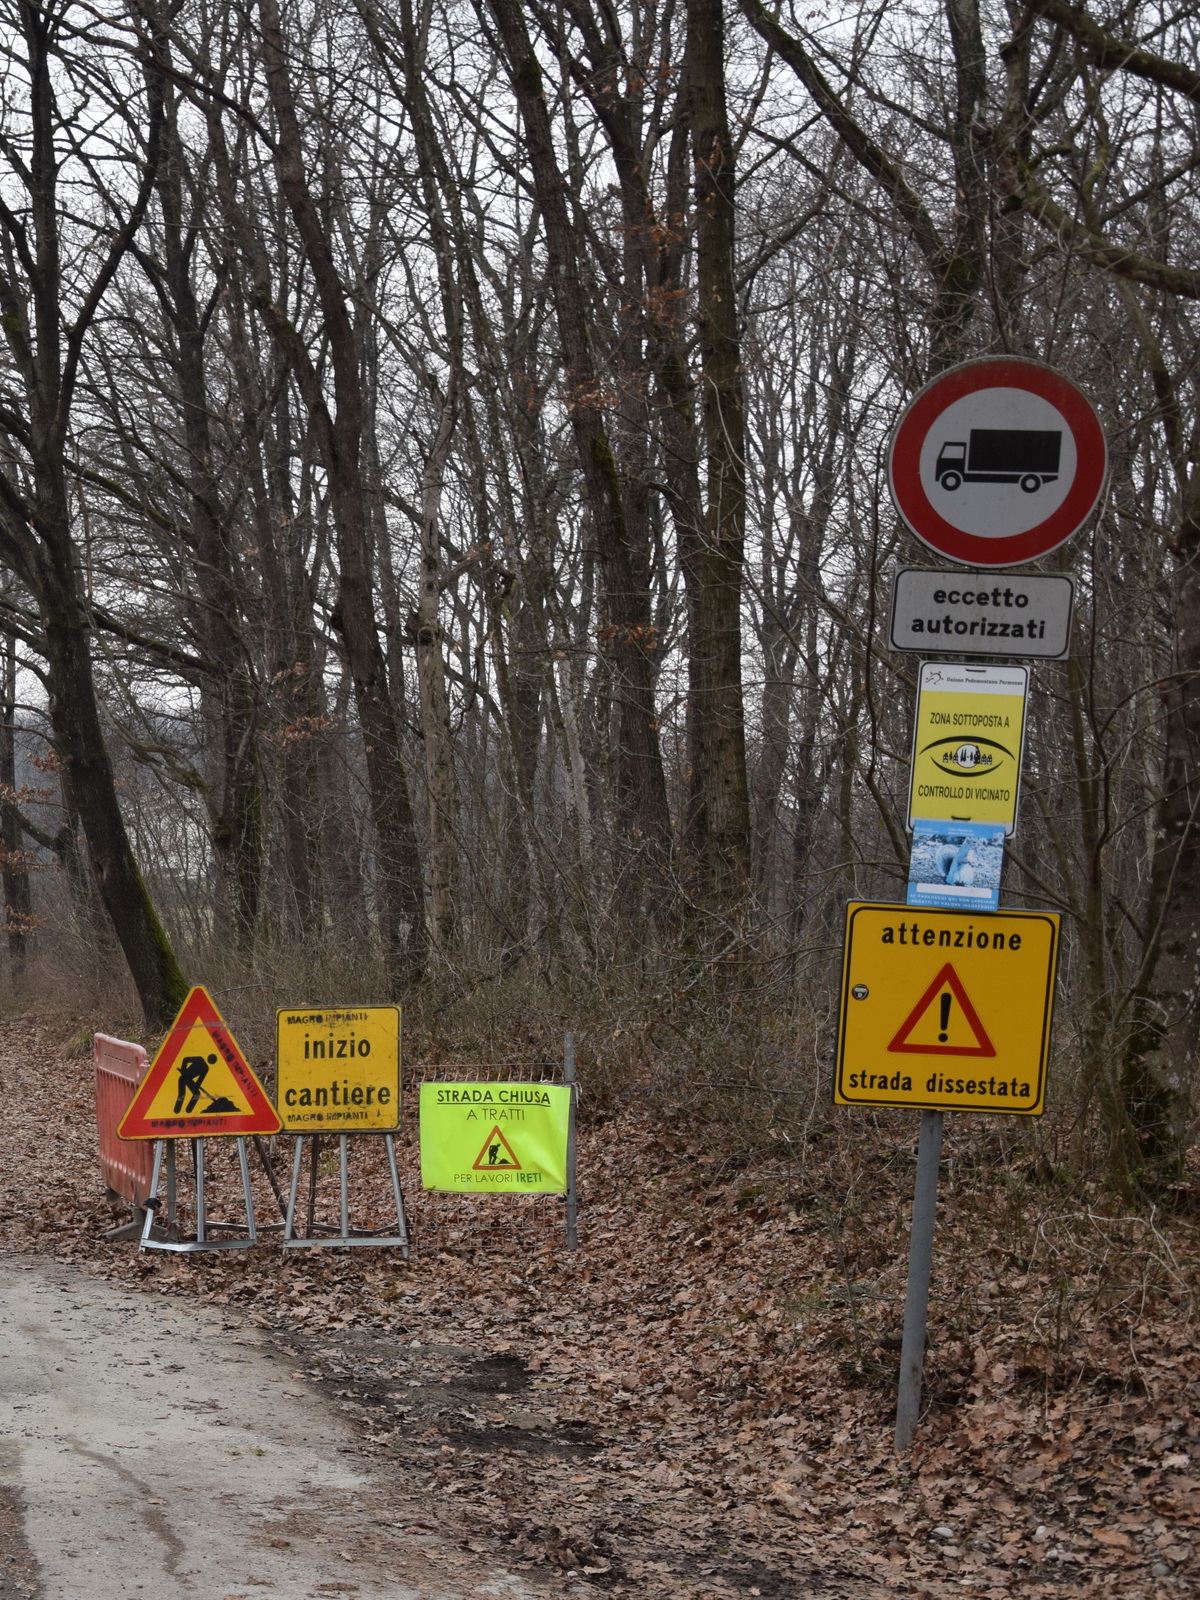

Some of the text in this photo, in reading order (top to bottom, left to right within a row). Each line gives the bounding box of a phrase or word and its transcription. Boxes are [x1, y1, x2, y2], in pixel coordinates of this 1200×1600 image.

[933, 587, 1029, 608] eccetto
[911, 615, 1045, 639] autorizzati
[930, 712, 1010, 728] ZONA SOTTOPOSTA A
[918, 785, 1010, 802] CONTROLLO DI VICINATO
[881, 922, 1022, 951] attenzione
[287, 1012, 368, 1025] MAGRO IMPIANTI
[304, 1033, 371, 1059] inizio
[849, 1070, 1031, 1098] strada dissestata
[285, 1080, 391, 1107] cantiere
[437, 1090, 551, 1105] STRADA CHIUSA
[288, 1111, 368, 1123] MAGRO IMPIANTI
[466, 1108, 525, 1121] A TRATTI
[453, 1172, 542, 1183] PER LAVORI IRETI
